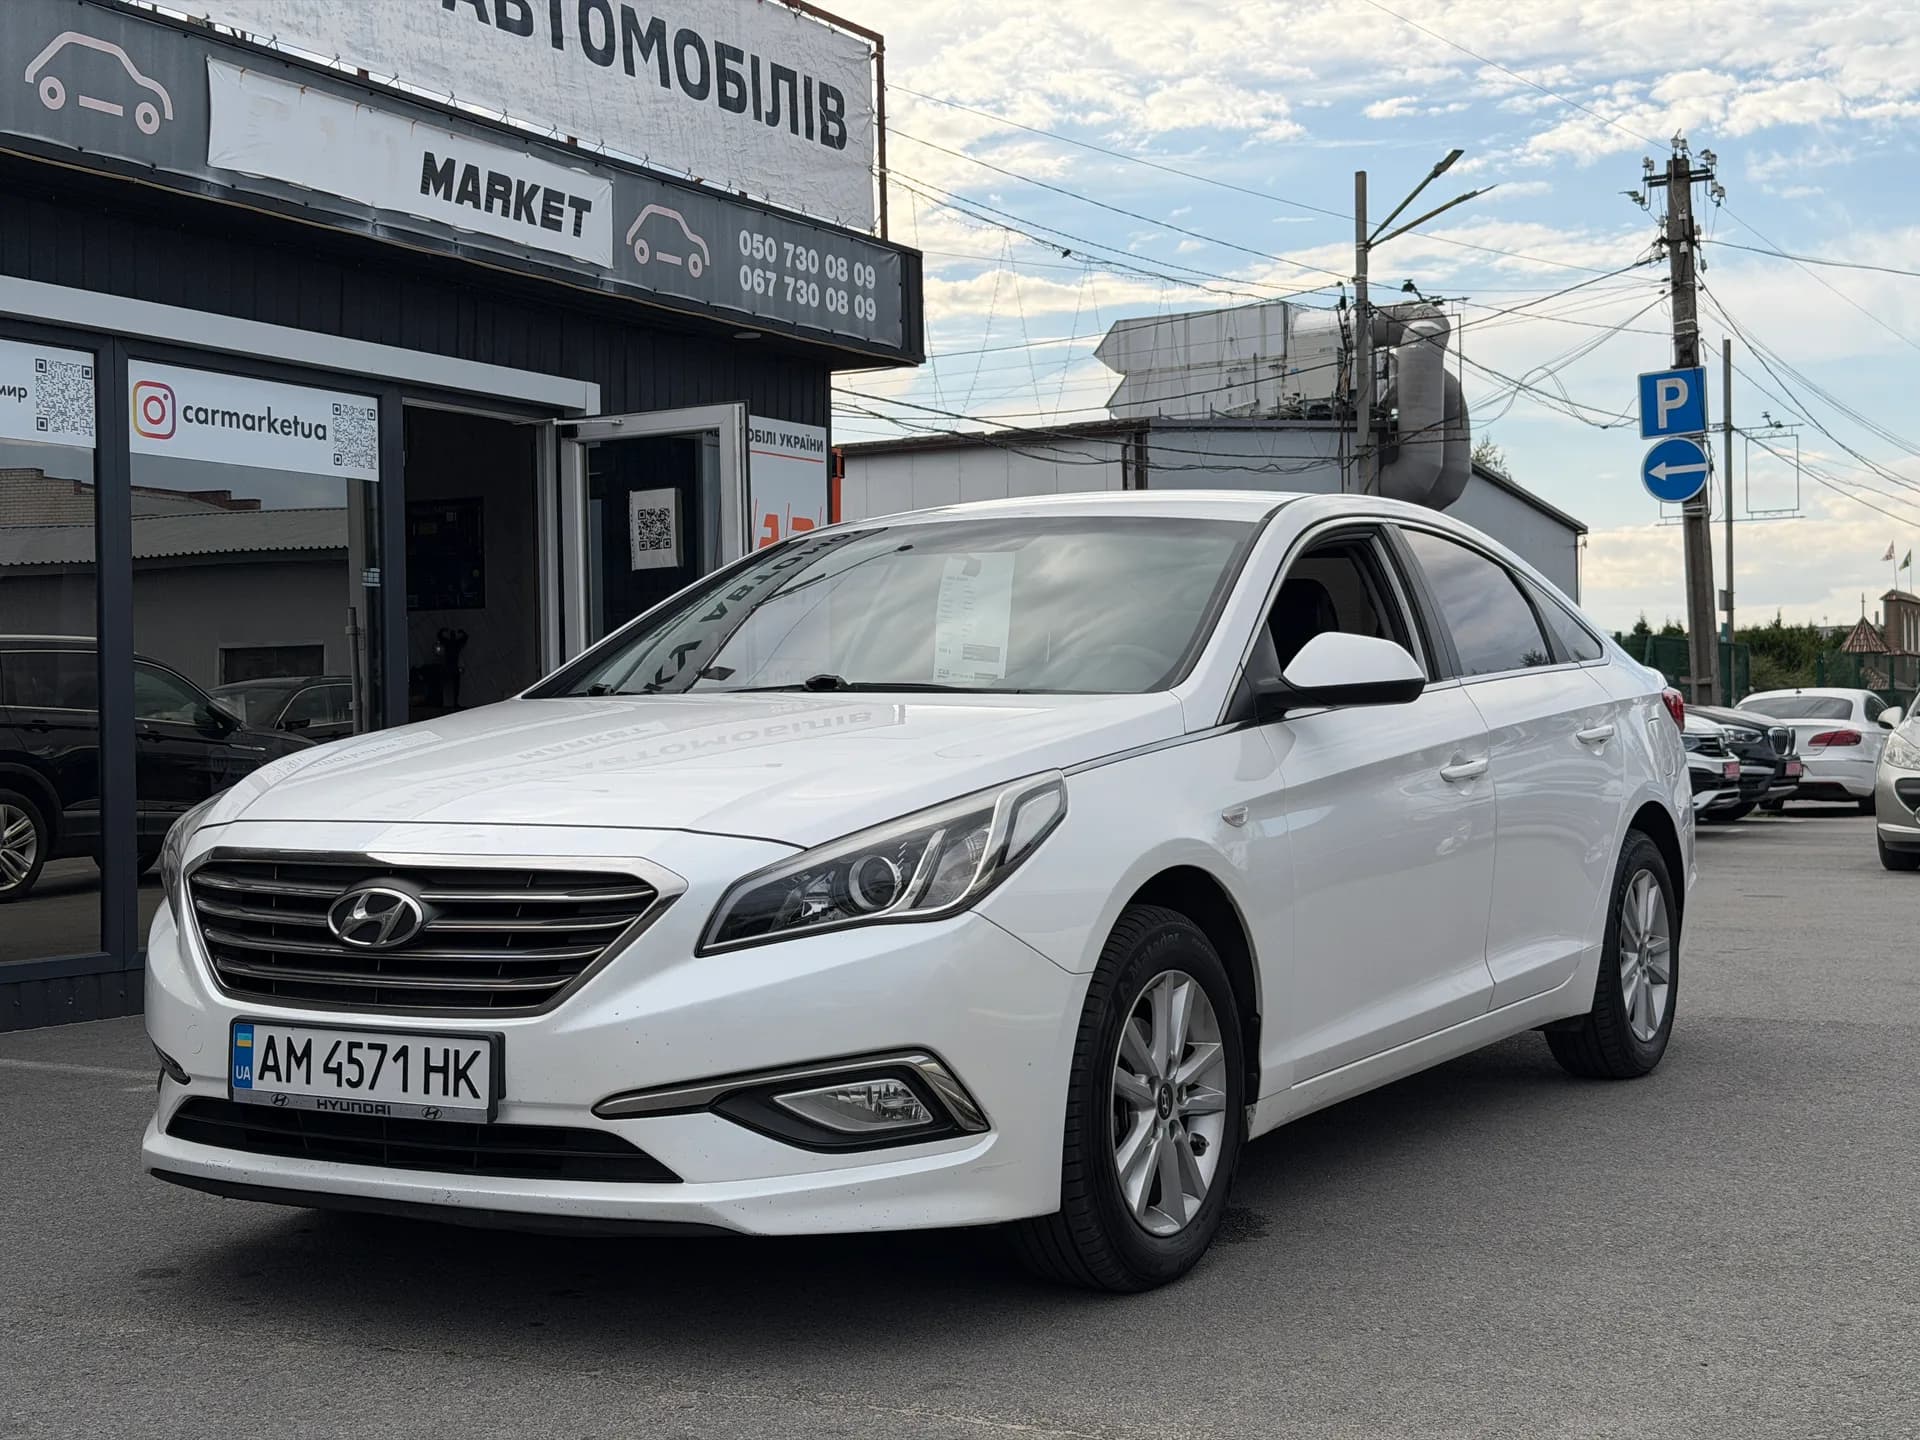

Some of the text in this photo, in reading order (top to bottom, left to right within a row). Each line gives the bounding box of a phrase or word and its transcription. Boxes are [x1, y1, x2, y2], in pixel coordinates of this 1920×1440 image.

[420, 151, 592, 238] MARKET
[739, 230, 876, 289] 050 730 08 09
[739, 265, 877, 321] 067 730 08 09
[182, 404, 328, 442] carmarketua
[1656, 377, 1689, 430] P
[780, 434, 824, 453] УКРАЇНИ
[235, 1064, 251, 1081] UA
[258, 1034, 482, 1100] AM 4571 HK
[316, 1098, 392, 1116] HYUNDAI
